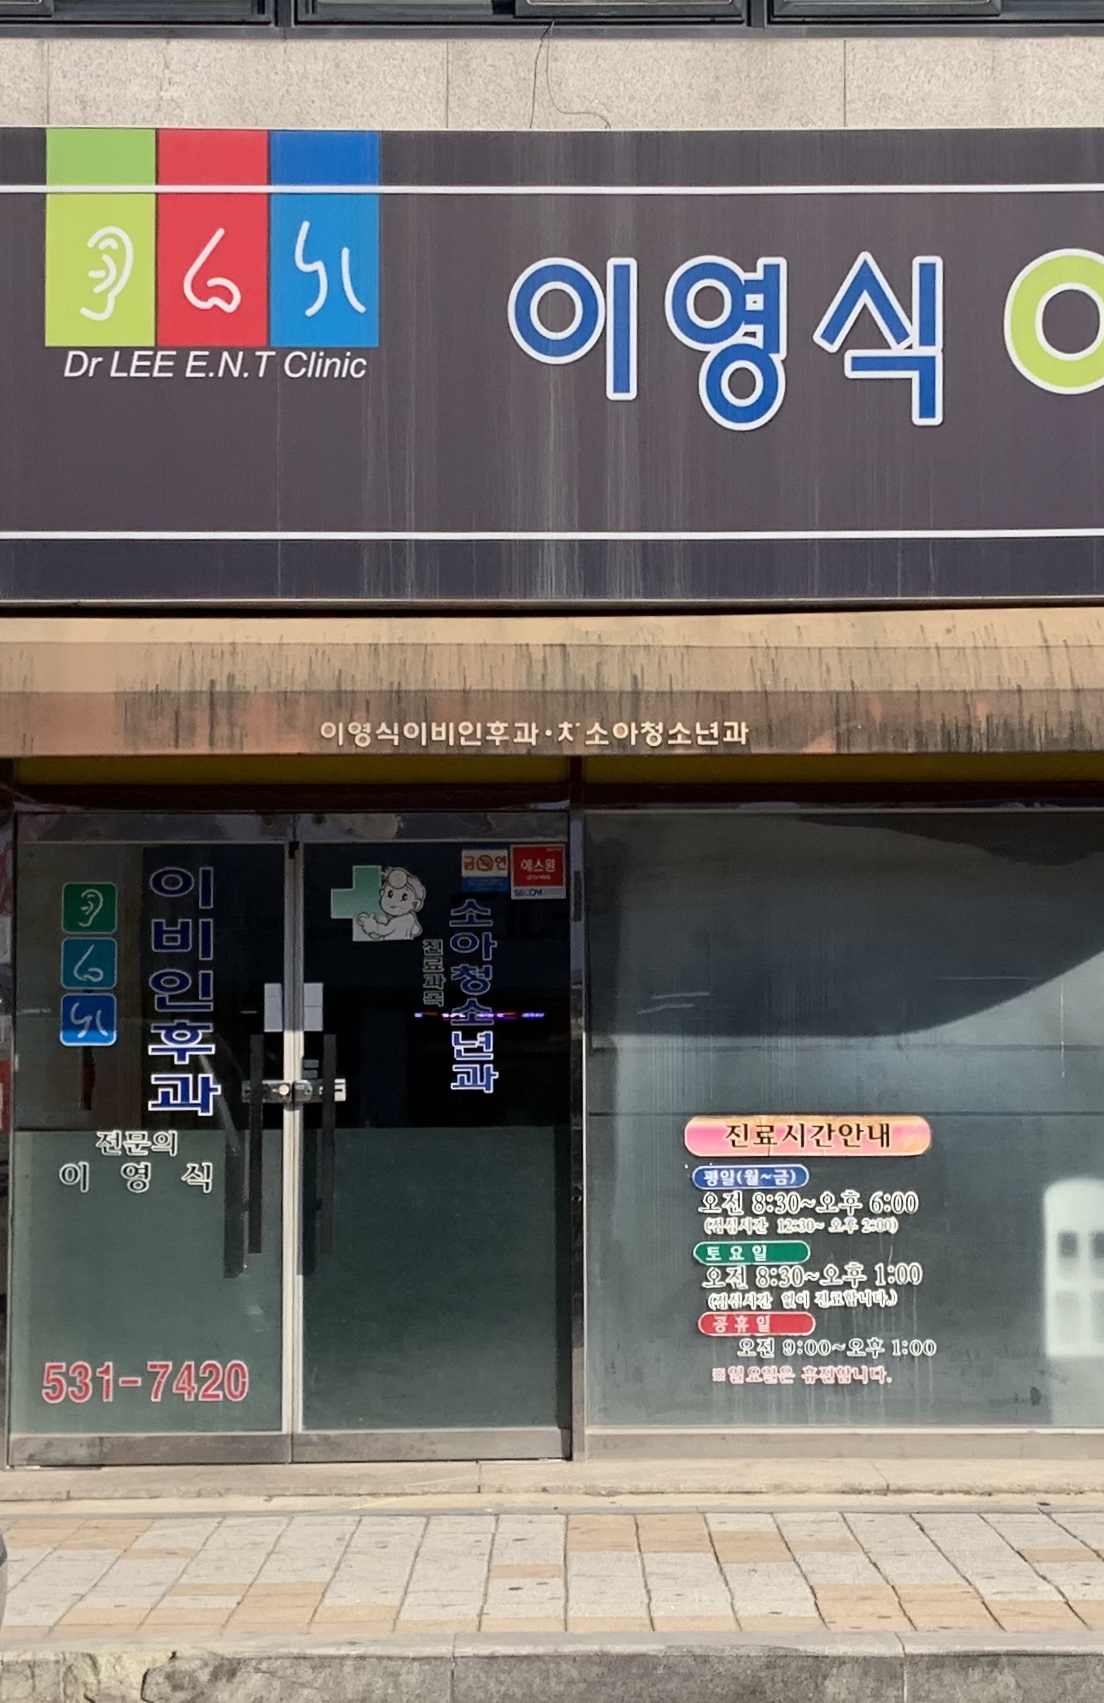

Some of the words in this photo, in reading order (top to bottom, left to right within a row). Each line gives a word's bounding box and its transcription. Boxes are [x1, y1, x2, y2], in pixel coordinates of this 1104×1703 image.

[507, 251, 944, 431] 이영식
[63, 350, 101, 379] Dr
[109, 350, 175, 379] LEE
[184, 350, 275, 379] E.N.T
[283, 349, 368, 379] Clinic
[521, 858, 556, 872] 에스원
[148, 866, 221, 1116] 이비인후과
[449, 899, 499, 1093] 소아청소년과
[96, 1130, 178, 1156] 전문의
[725, 1123, 891, 1148] 진료시간안내
[703, 1170, 797, 1187] 평일(월~금)
[698, 1191, 744, 1215] 오전
[751, 1190, 863, 1215] 8:30~오후
[868, 1191, 919, 1214] 6:00
[702, 1266, 748, 1289] 오전
[755, 1262, 867, 1288] 8:30~오후
[874, 1262, 923, 1286] 1:00
[737, 1338, 775, 1358] 오전
[782, 1337, 885, 1357] 9:00~오후
[892, 1338, 937, 1356] 1:00
[42, 1361, 249, 1403] 531-7420
